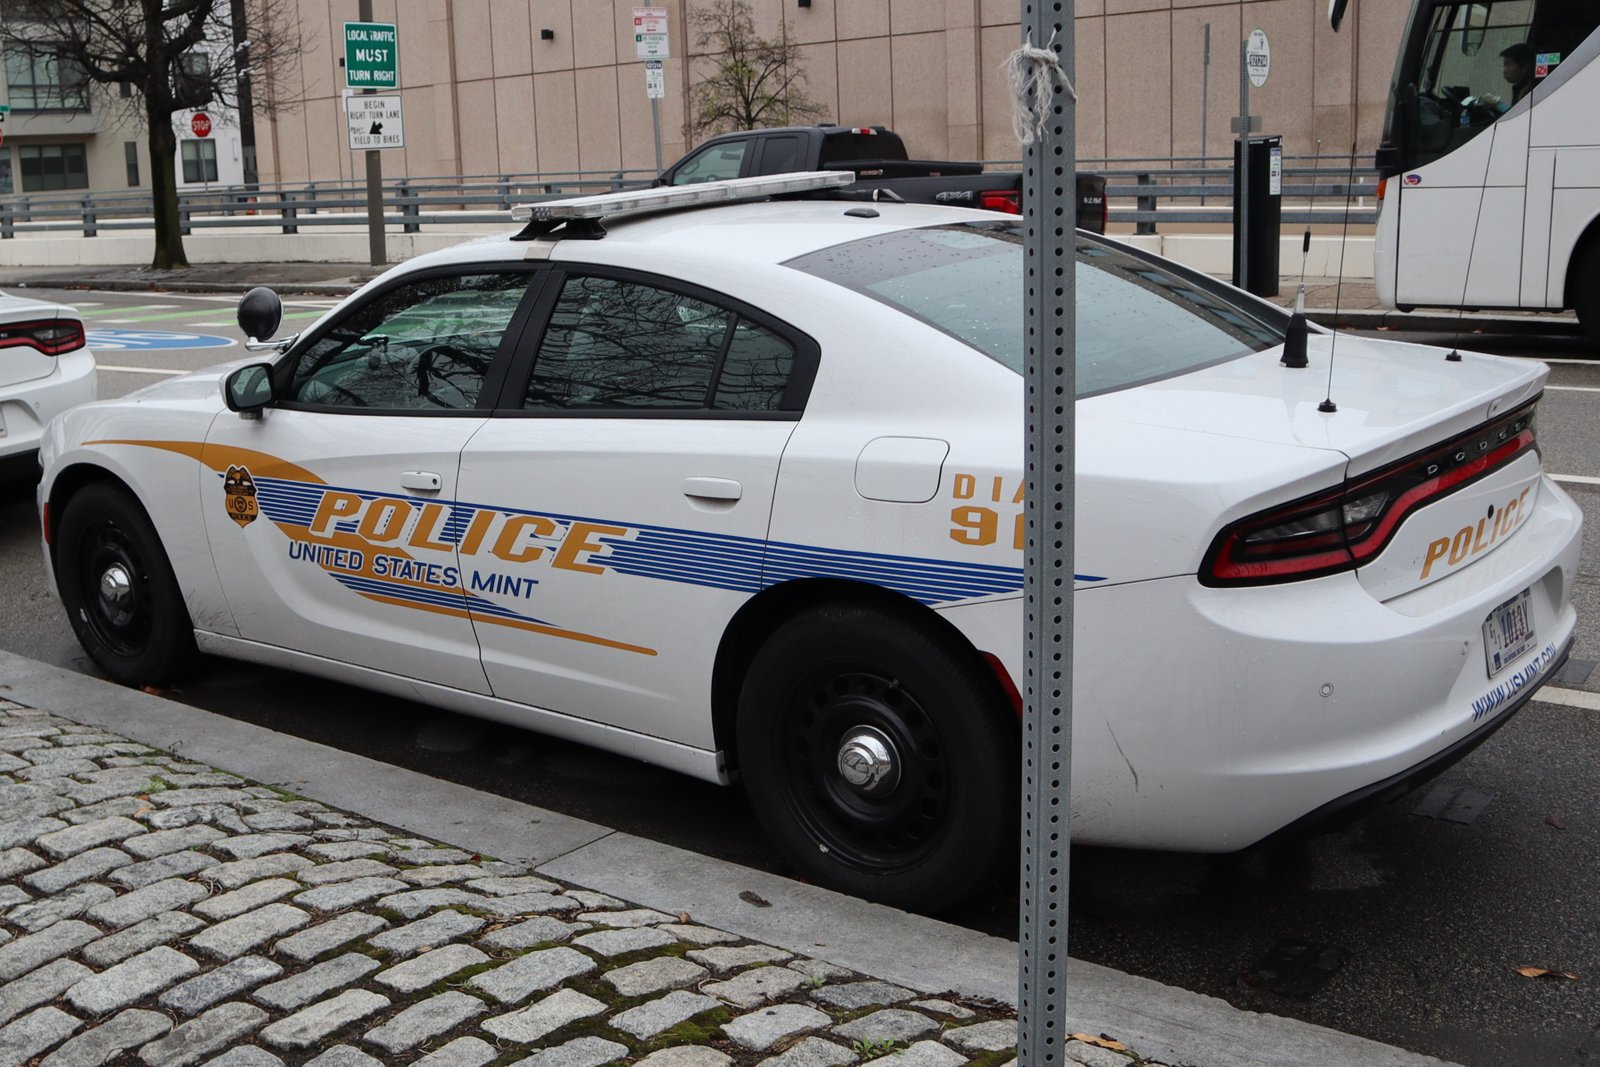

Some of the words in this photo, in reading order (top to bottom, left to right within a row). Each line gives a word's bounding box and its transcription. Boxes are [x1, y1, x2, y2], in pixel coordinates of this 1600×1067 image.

[347, 30, 368, 41] LOCAL
[370, 30, 395, 42] TRAFFIC
[355, 48, 388, 62] MUST
[349, 70, 370, 81] TURN
[373, 71, 395, 82] RIGHT
[363, 100, 385, 110] BEGIN
[350, 111, 366, 120] RIGHT
[369, 111, 383, 120] TURN
[386, 110, 400, 119] LANE
[192, 120, 210, 131] STOP
[354, 136, 371, 145] YIELD
[373, 135, 381, 144] TO
[383, 134, 400, 144] BIKES
[1427, 422, 1522, 475] DODGE
[310, 491, 629, 575] POLICE
[1419, 485, 1531, 580] POLICE
[288, 541, 363, 571] UNITED
[374, 556, 458, 586] STATES
[471, 570, 539, 599] MINT
